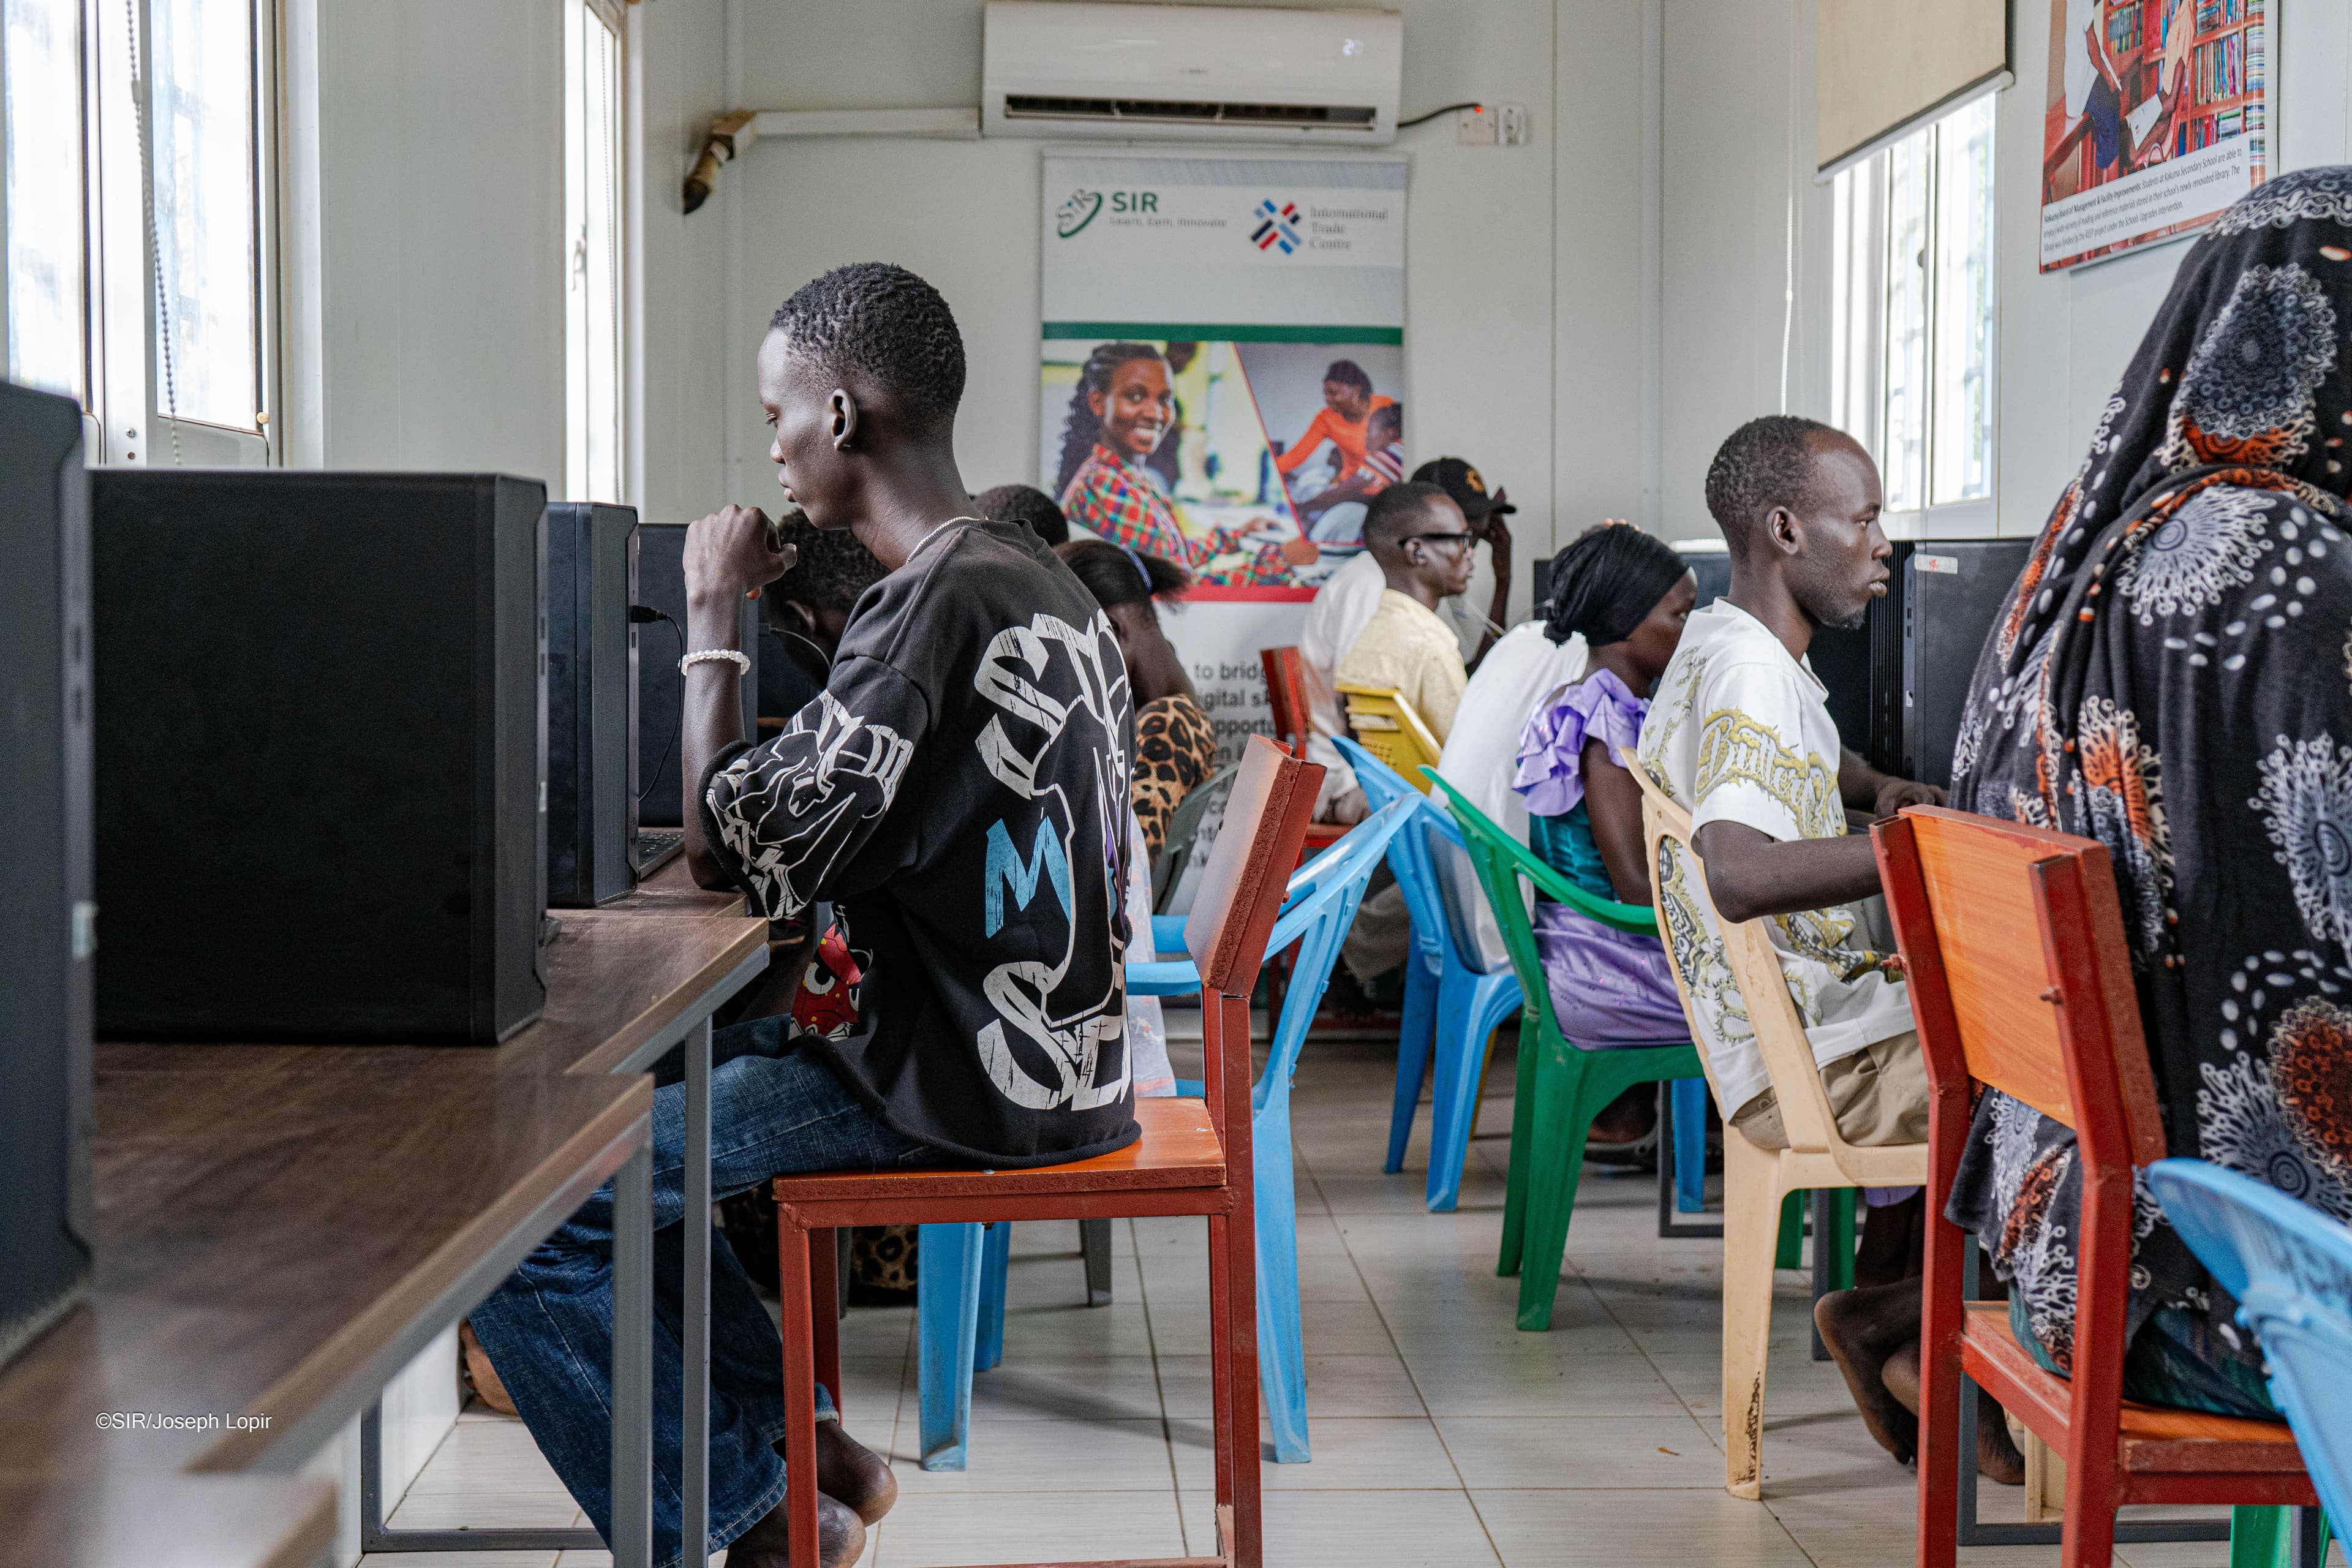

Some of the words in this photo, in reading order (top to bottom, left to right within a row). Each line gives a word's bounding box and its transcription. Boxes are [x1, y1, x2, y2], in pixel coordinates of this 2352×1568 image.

[2181, 162, 2202, 177] Secondary
[2203, 154, 2217, 168] School
[2226, 149, 2236, 160] able
[2193, 173, 2214, 187] renovated
[2214, 168, 2230, 182] library.
[2231, 164, 2241, 175] The
[1112, 192, 1158, 213] SIR
[1194, 662, 1213, 680] to
